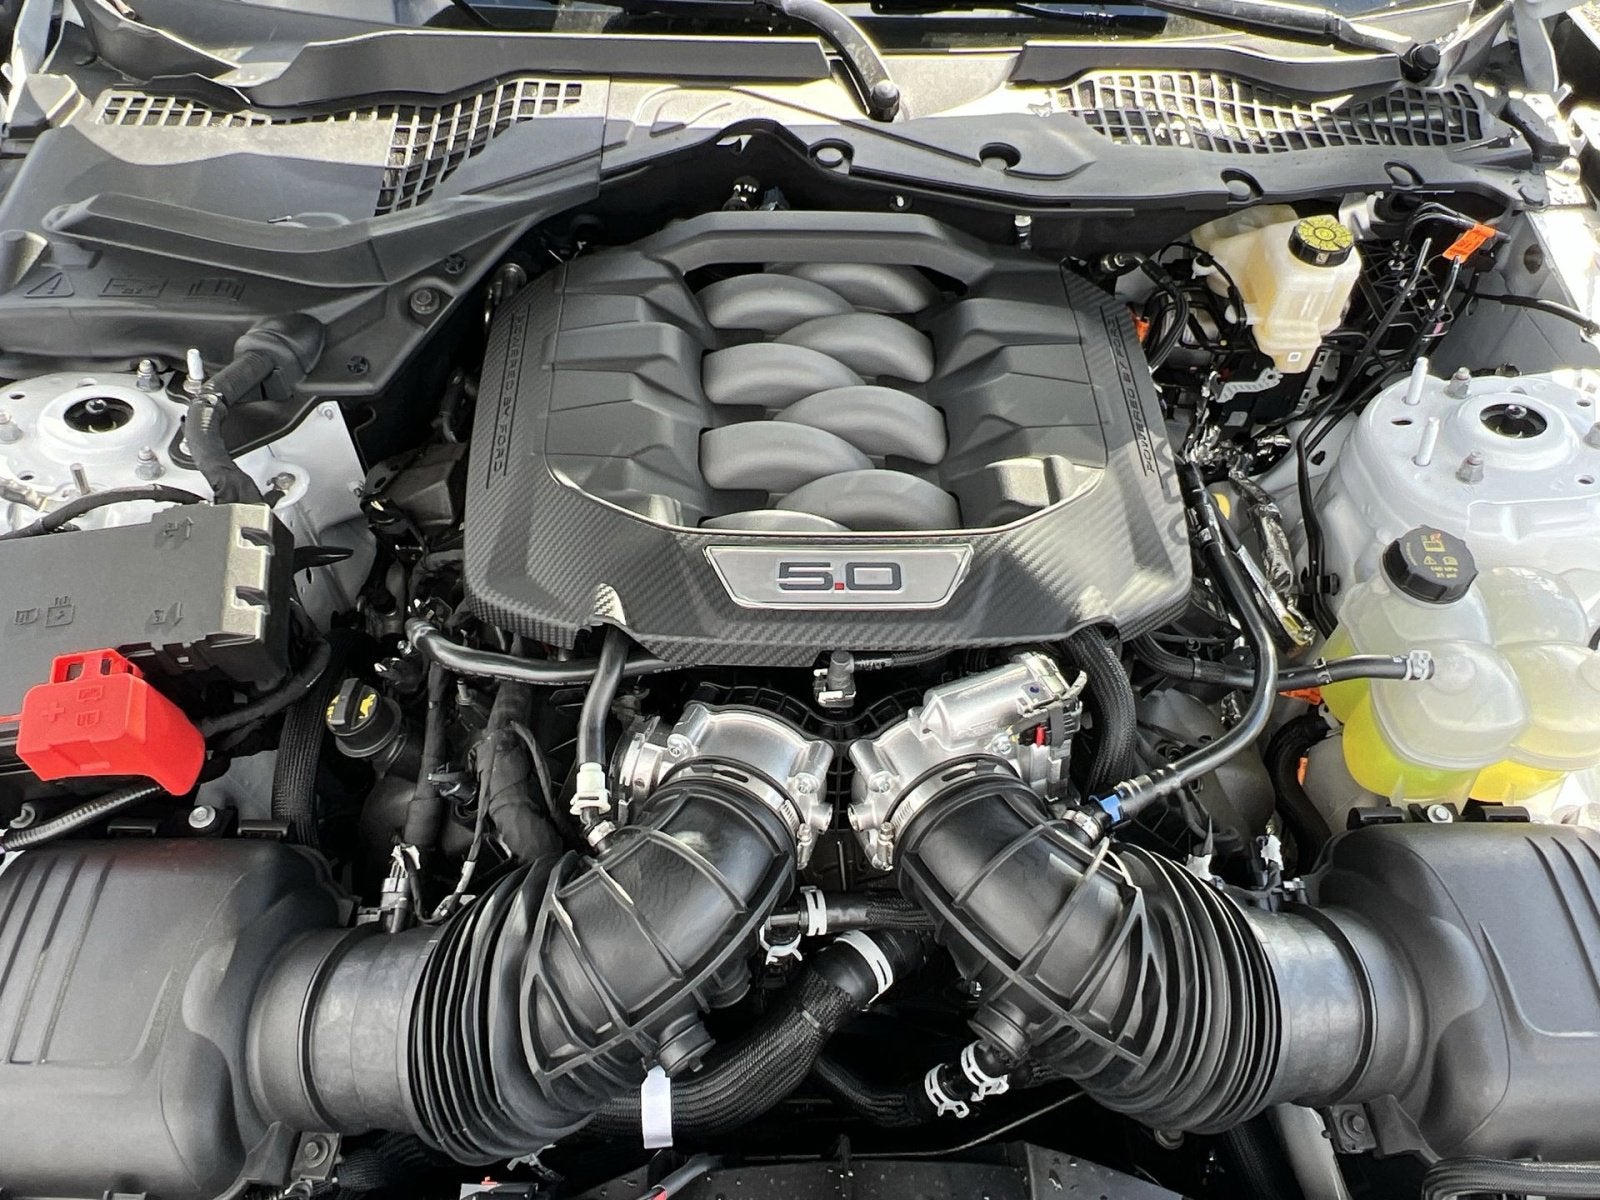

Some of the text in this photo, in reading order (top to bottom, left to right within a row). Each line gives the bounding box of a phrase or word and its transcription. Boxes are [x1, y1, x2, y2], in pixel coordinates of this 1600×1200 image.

[1119, 361, 1132, 383] BY
[503, 397, 512, 417] BY
[1127, 387, 1156, 474] POWERED
[493, 423, 508, 473] FORD
[778, 562, 902, 591] 5.0
